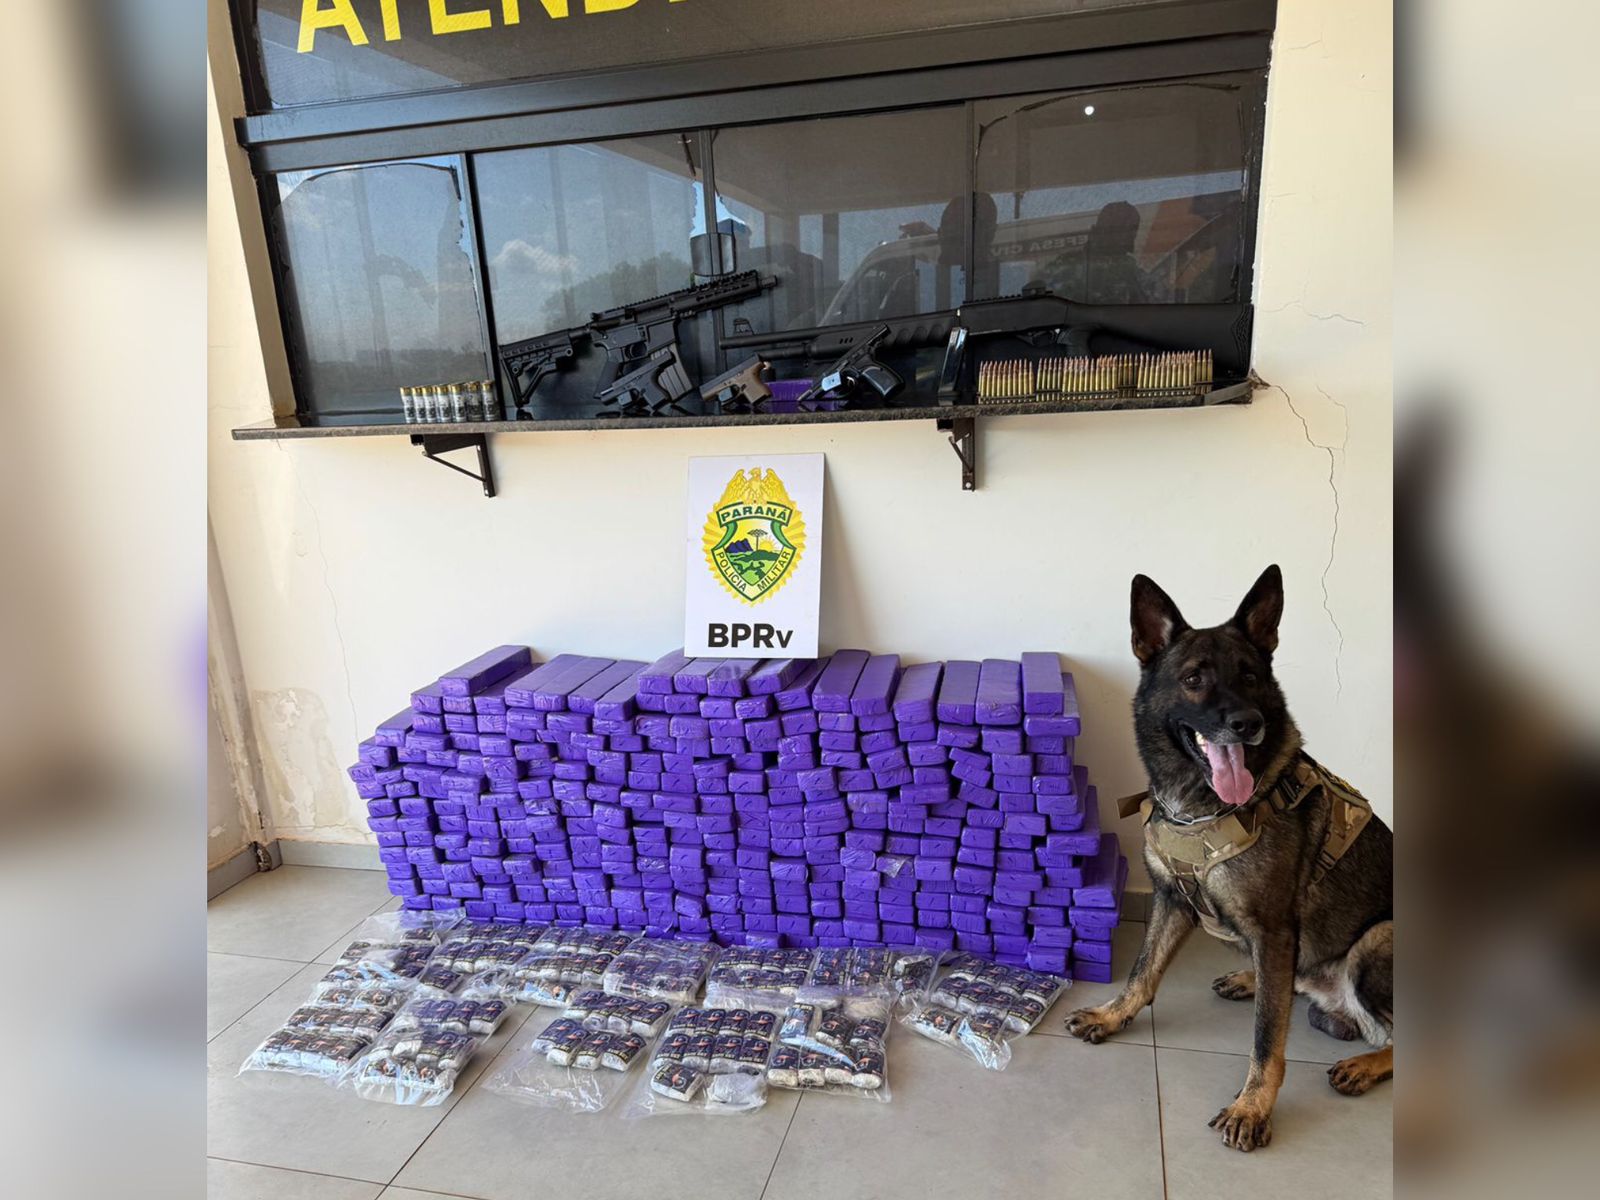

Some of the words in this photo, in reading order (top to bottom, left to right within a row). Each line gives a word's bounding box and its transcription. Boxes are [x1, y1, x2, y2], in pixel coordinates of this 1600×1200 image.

[720, 505, 787, 522] PARANÁ
[757, 551, 791, 592] MILITAR
[707, 622, 794, 649] BPRv
